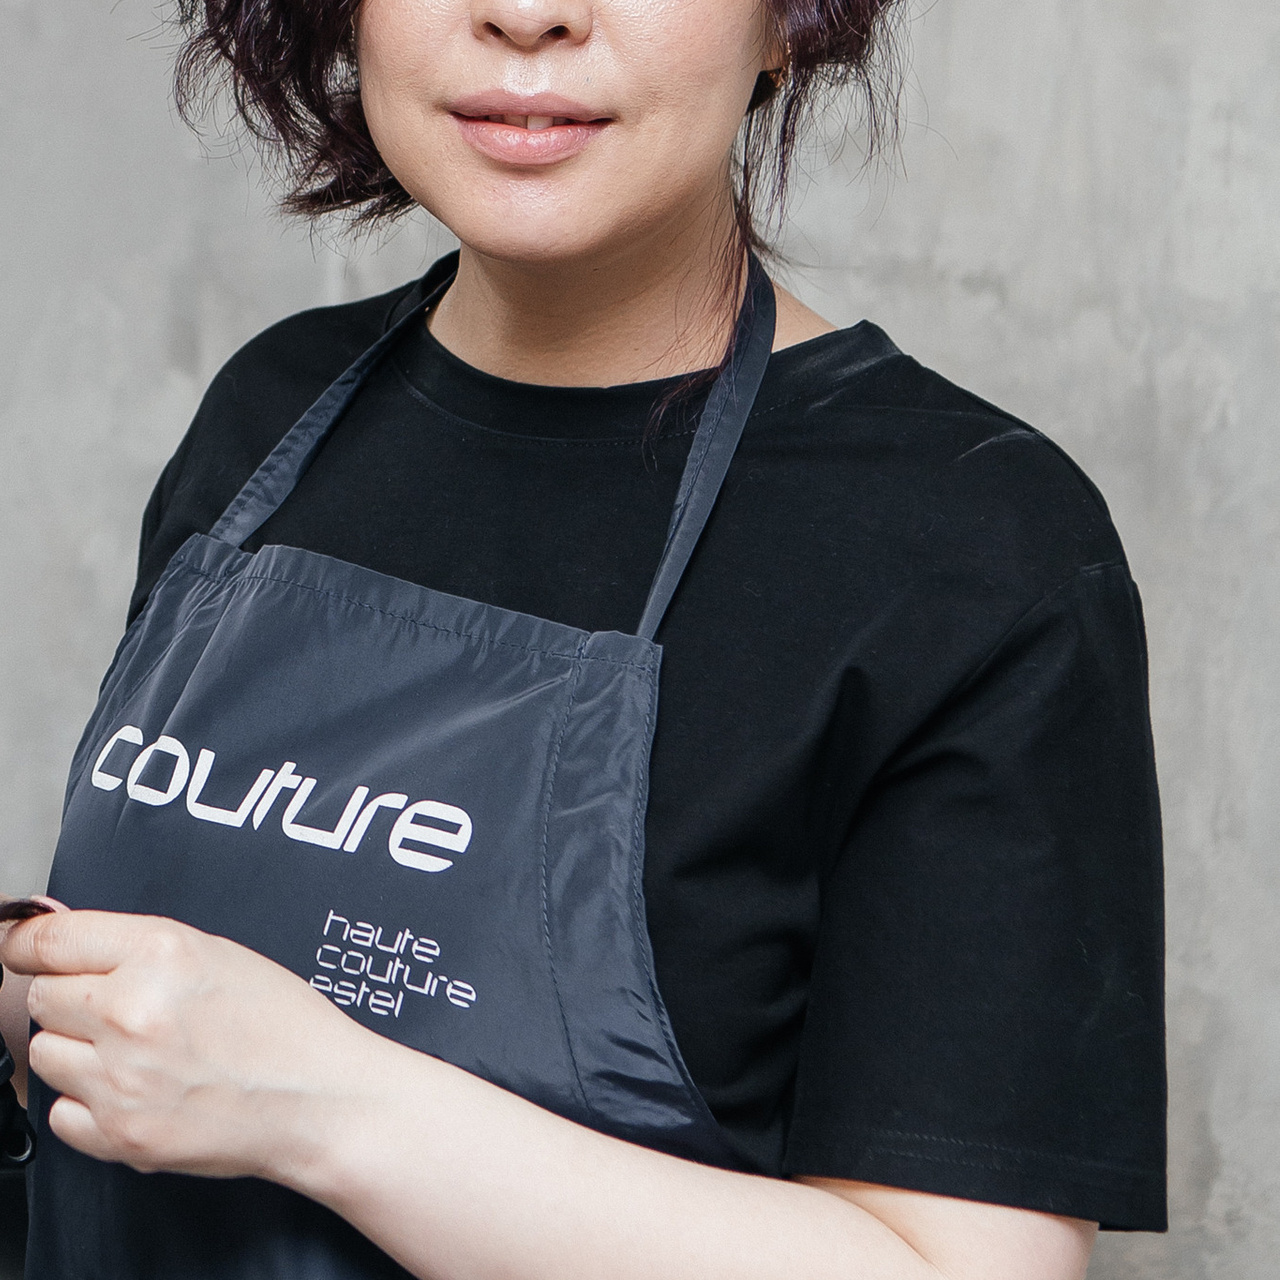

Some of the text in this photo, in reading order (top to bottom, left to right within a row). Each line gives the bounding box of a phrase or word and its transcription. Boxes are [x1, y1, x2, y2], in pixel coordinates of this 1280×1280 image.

[91, 725, 473, 872] couture
[323, 909, 441, 963] haute
[309, 974, 404, 1018] estel
[316, 944, 477, 1008] couture
